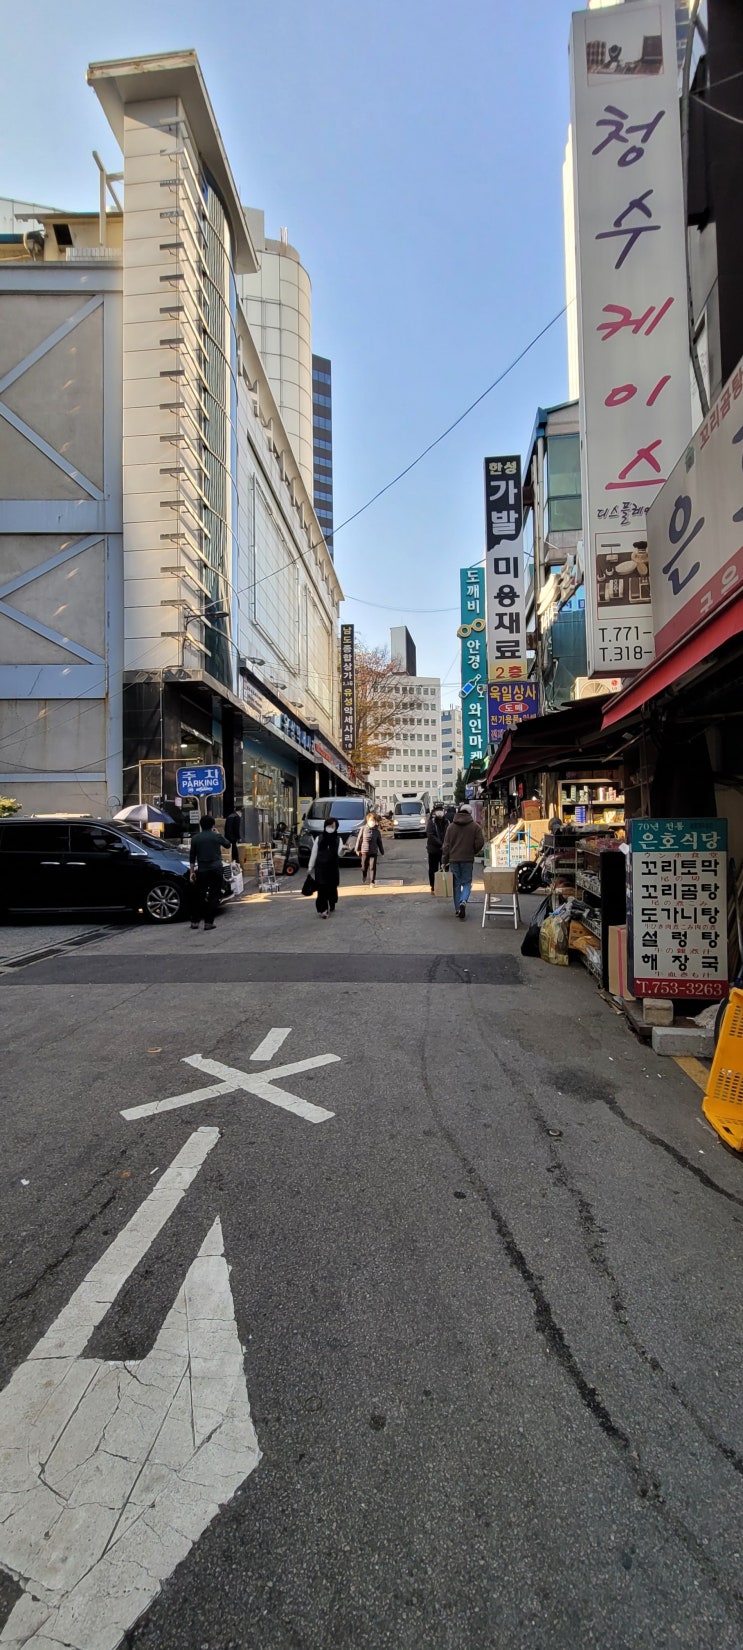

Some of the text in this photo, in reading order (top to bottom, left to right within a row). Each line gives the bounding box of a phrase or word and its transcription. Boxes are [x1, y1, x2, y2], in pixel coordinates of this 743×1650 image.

[592, 104, 675, 491] 청수케이스
[488, 461, 517, 475] 한성
[489, 480, 522, 660] 가발 미용재료
[466, 570, 480, 614] 도깨비
[342, 626, 353, 680] 남도종합상가
[466, 639, 481, 670] 안경
[495, 665, 523, 679] 2층
[504, 704, 523, 712] 도매
[182, 779, 219, 788] PARKING
[637, 822, 684, 831] 70년 전통
[638, 831, 721, 850] 은호식당
[641, 859, 720, 877] 꼬리토막
[641, 883, 720, 901] 꼬리곰탕
[641, 907, 720, 925] 도가니탕
[641, 930, 720, 948] 설렁탕
[641, 954, 719, 972] 해장국
[640, 981, 722, 996] T.753-3263
